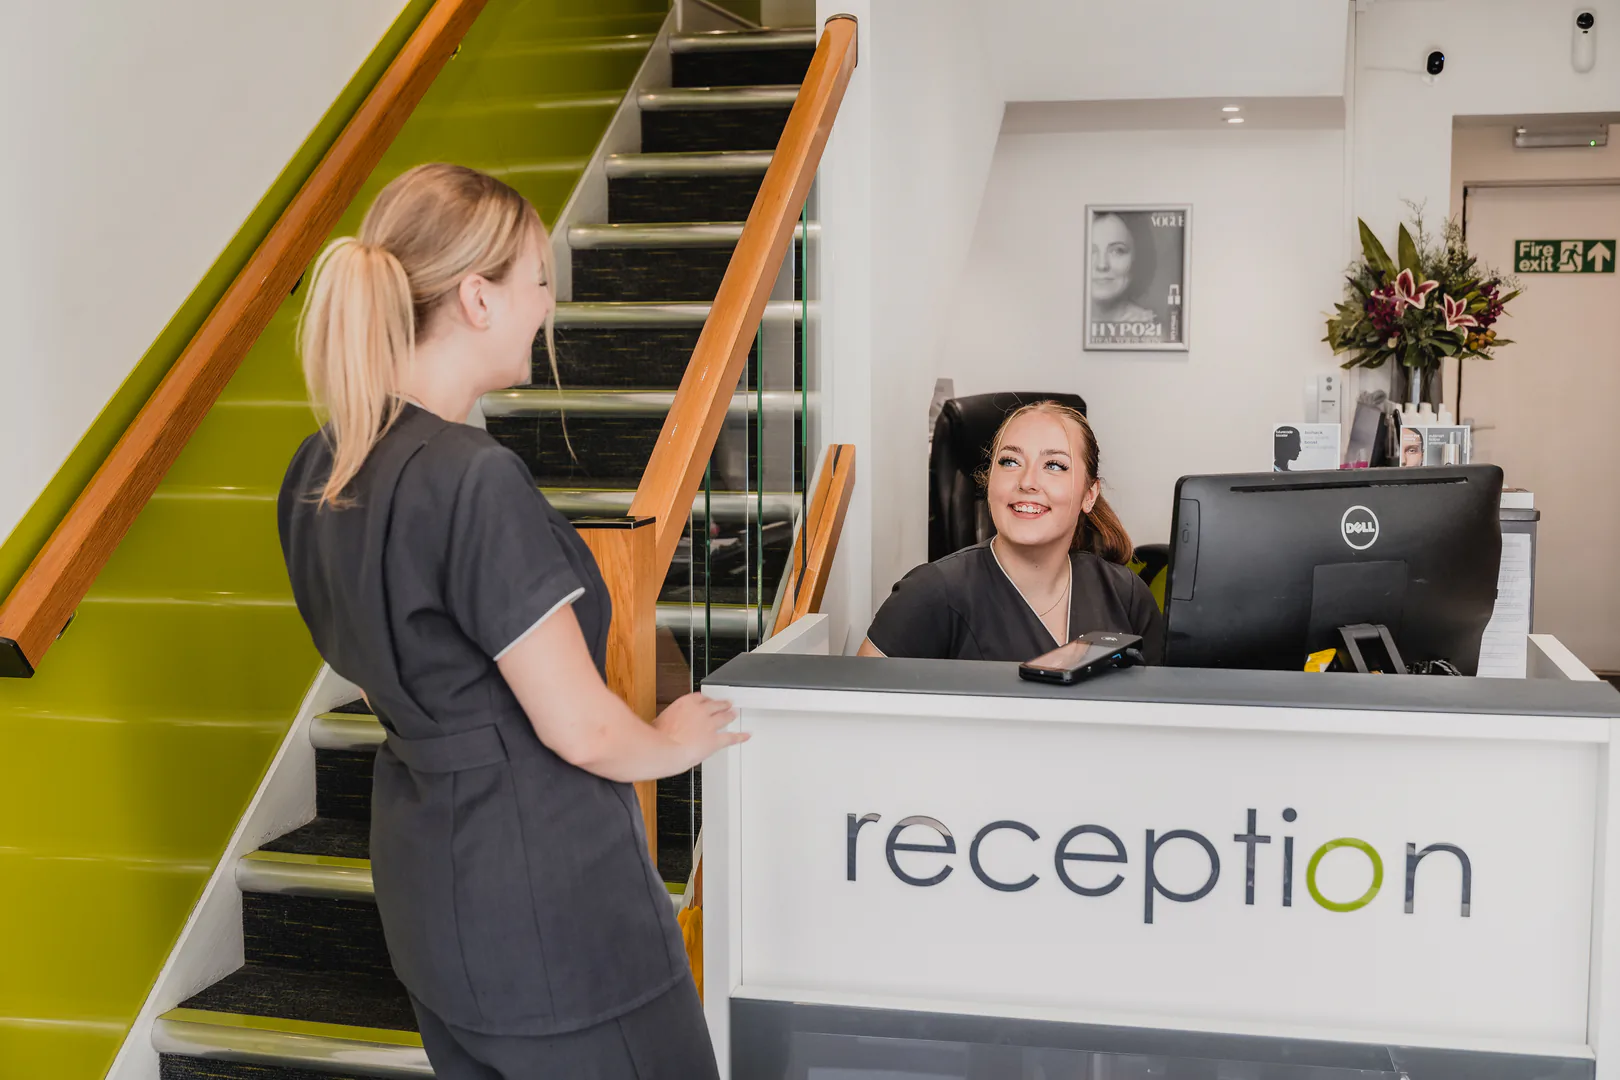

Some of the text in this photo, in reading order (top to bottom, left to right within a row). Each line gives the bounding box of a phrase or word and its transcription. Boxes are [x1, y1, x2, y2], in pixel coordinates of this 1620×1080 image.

[1519, 241, 1554, 257] Fire
[1519, 257, 1554, 272] exit
[1091, 322, 1163, 337] HYPO21
[1346, 521, 1375, 534] DELL
[846, 808, 1472, 924] reception
